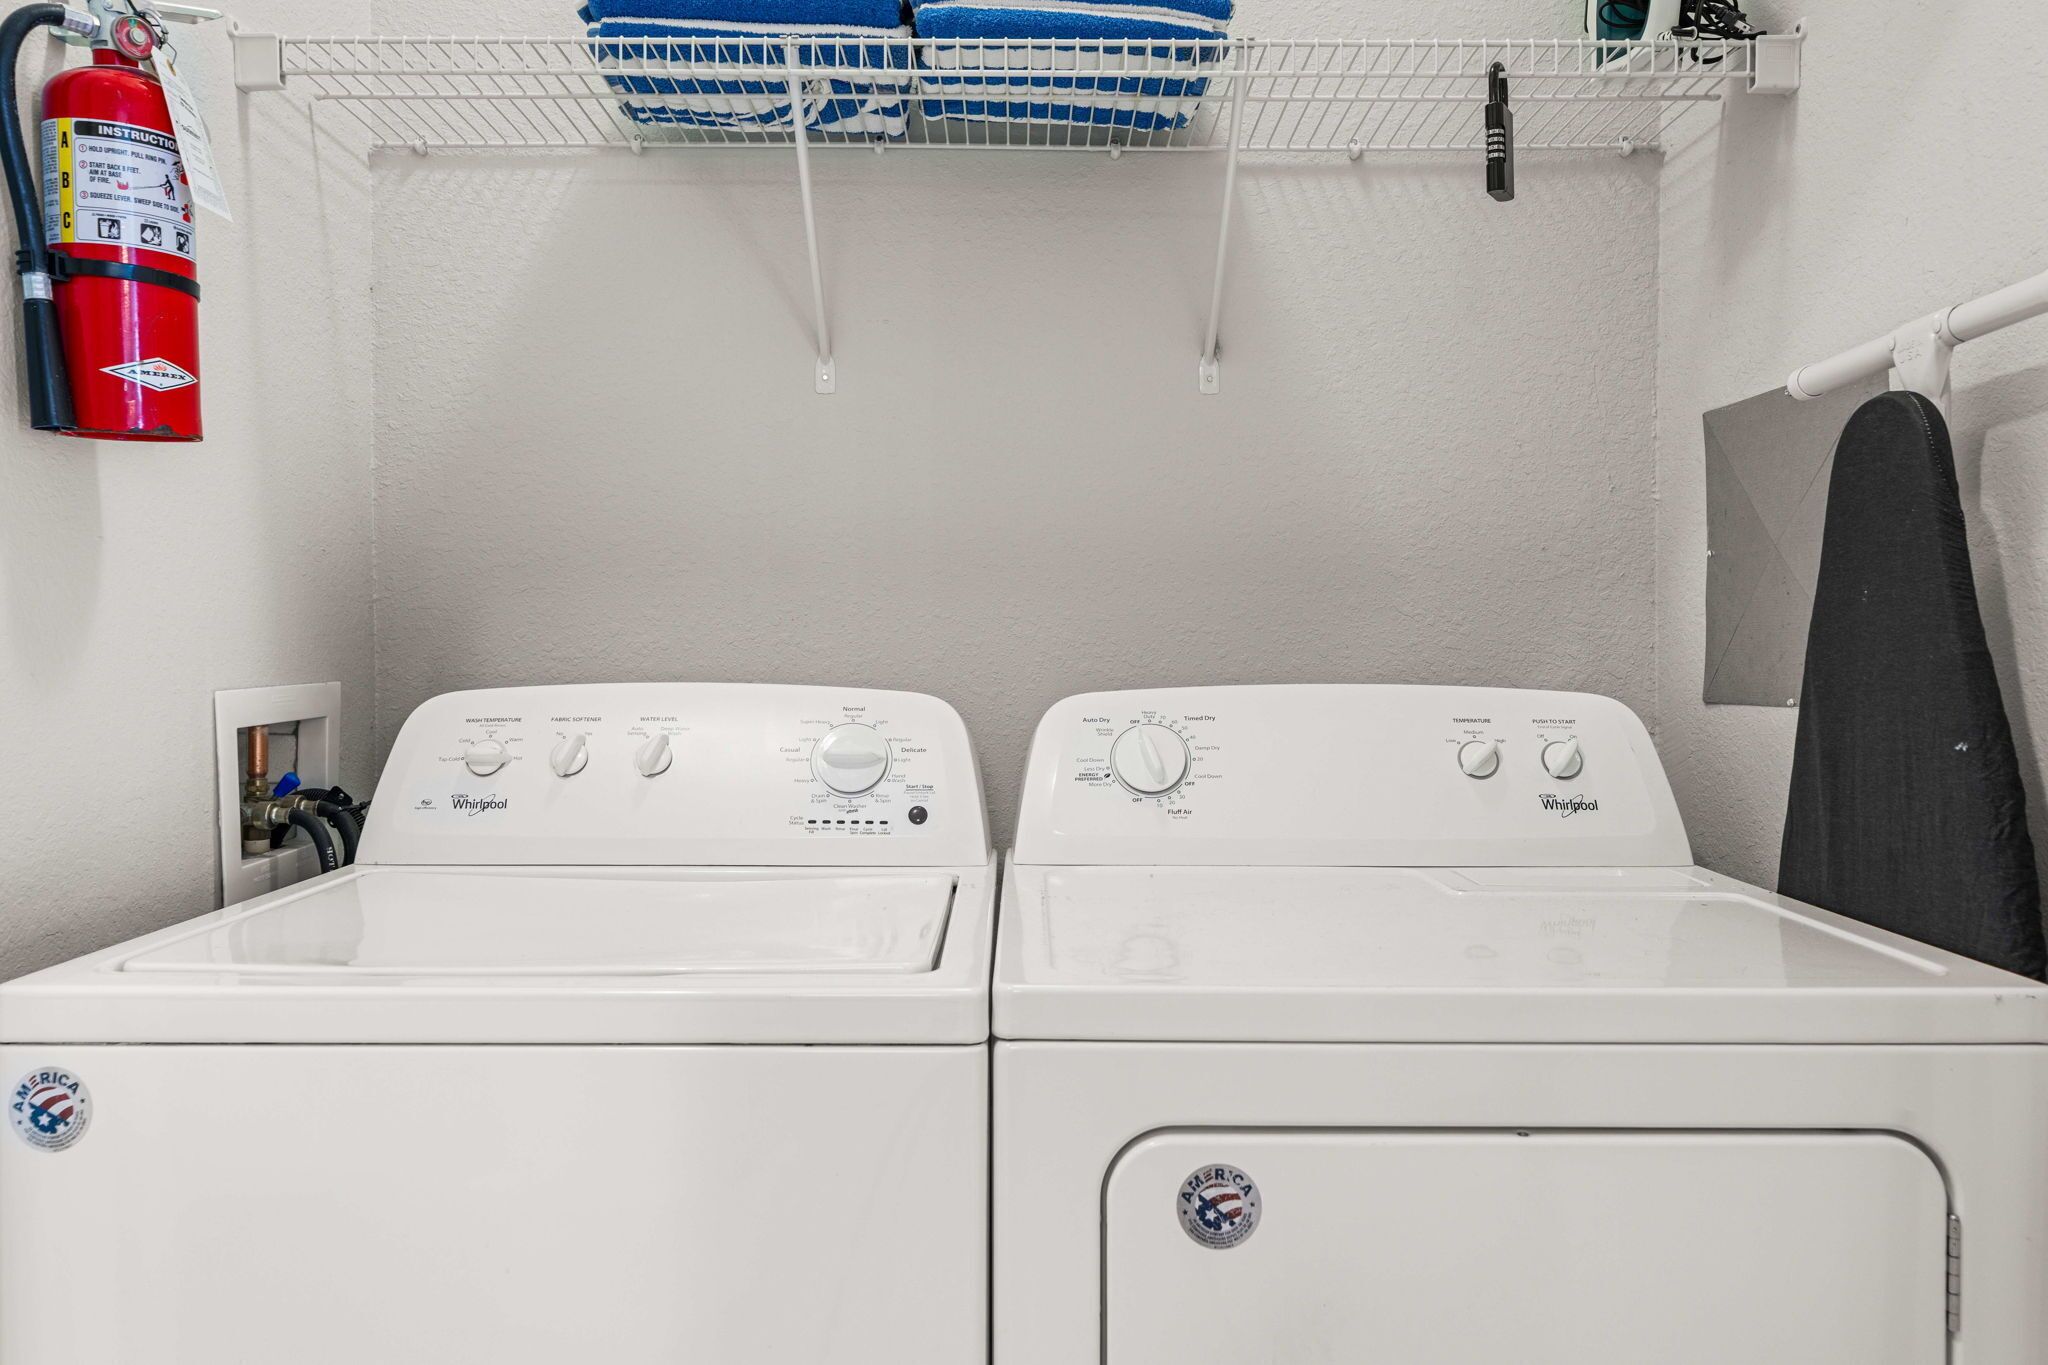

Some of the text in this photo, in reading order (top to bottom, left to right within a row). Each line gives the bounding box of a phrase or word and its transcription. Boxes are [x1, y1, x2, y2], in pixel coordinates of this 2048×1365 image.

[61, 131, 68, 148] A
[145, 153, 157, 162] RING
[107, 163, 121, 171] BACK
[62, 172, 69, 188] B
[90, 192, 112, 200] SQUEEZE
[134, 197, 152, 205] SWEEP
[152, 200, 163, 208] SIDE
[64, 212, 70, 228] C
[128, 370, 186, 380] AMEREX
[452, 798, 508, 812] Whirlpool
[1541, 799, 1598, 813] Whirlpool
[12, 1072, 80, 1112] AMERICA
[1181, 1168, 1252, 1204] AMERICA
